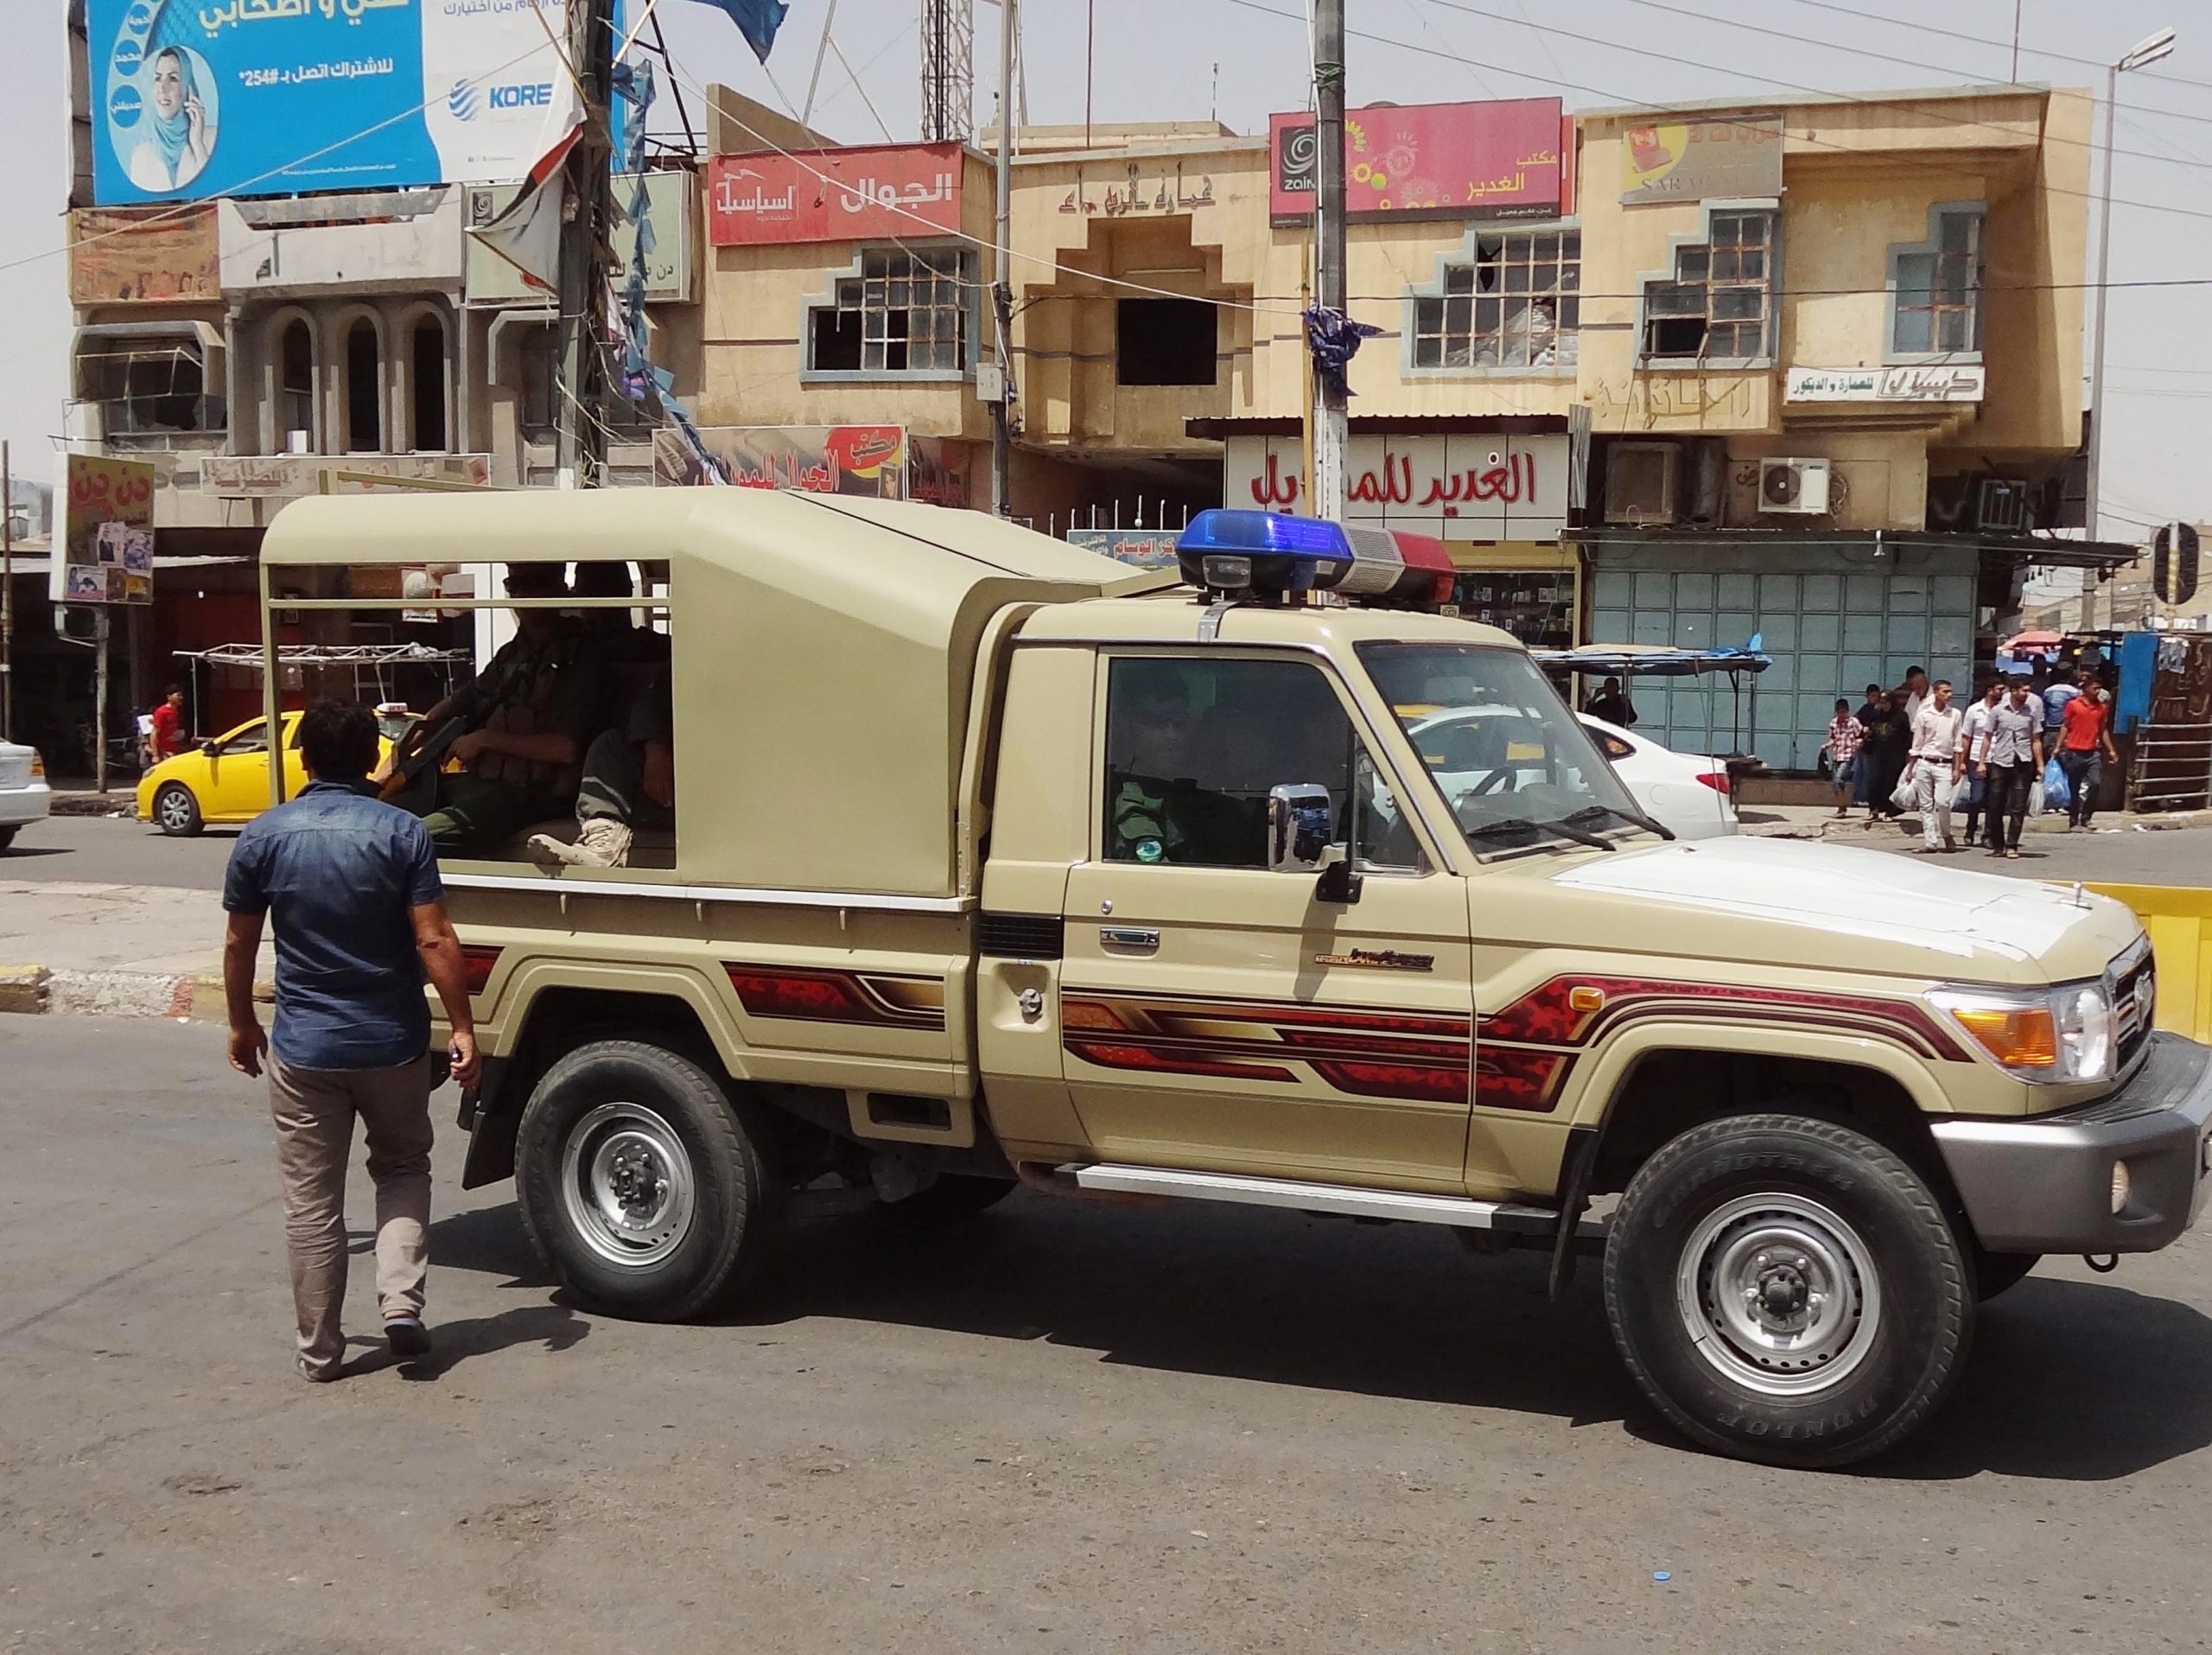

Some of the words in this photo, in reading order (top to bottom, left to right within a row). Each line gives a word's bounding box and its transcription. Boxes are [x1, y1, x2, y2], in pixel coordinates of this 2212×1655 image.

[292, 64, 328, 84] اتصل
[331, 56, 394, 80] للاشتراك
[489, 83, 554, 109] KORE
[1516, 149, 1557, 169] مكتب
[840, 173, 952, 213] الجوال
[1467, 172, 1525, 201] الغدير
[849, 430, 898, 466] مكتب
[1417, 451, 1535, 517] الغدير
